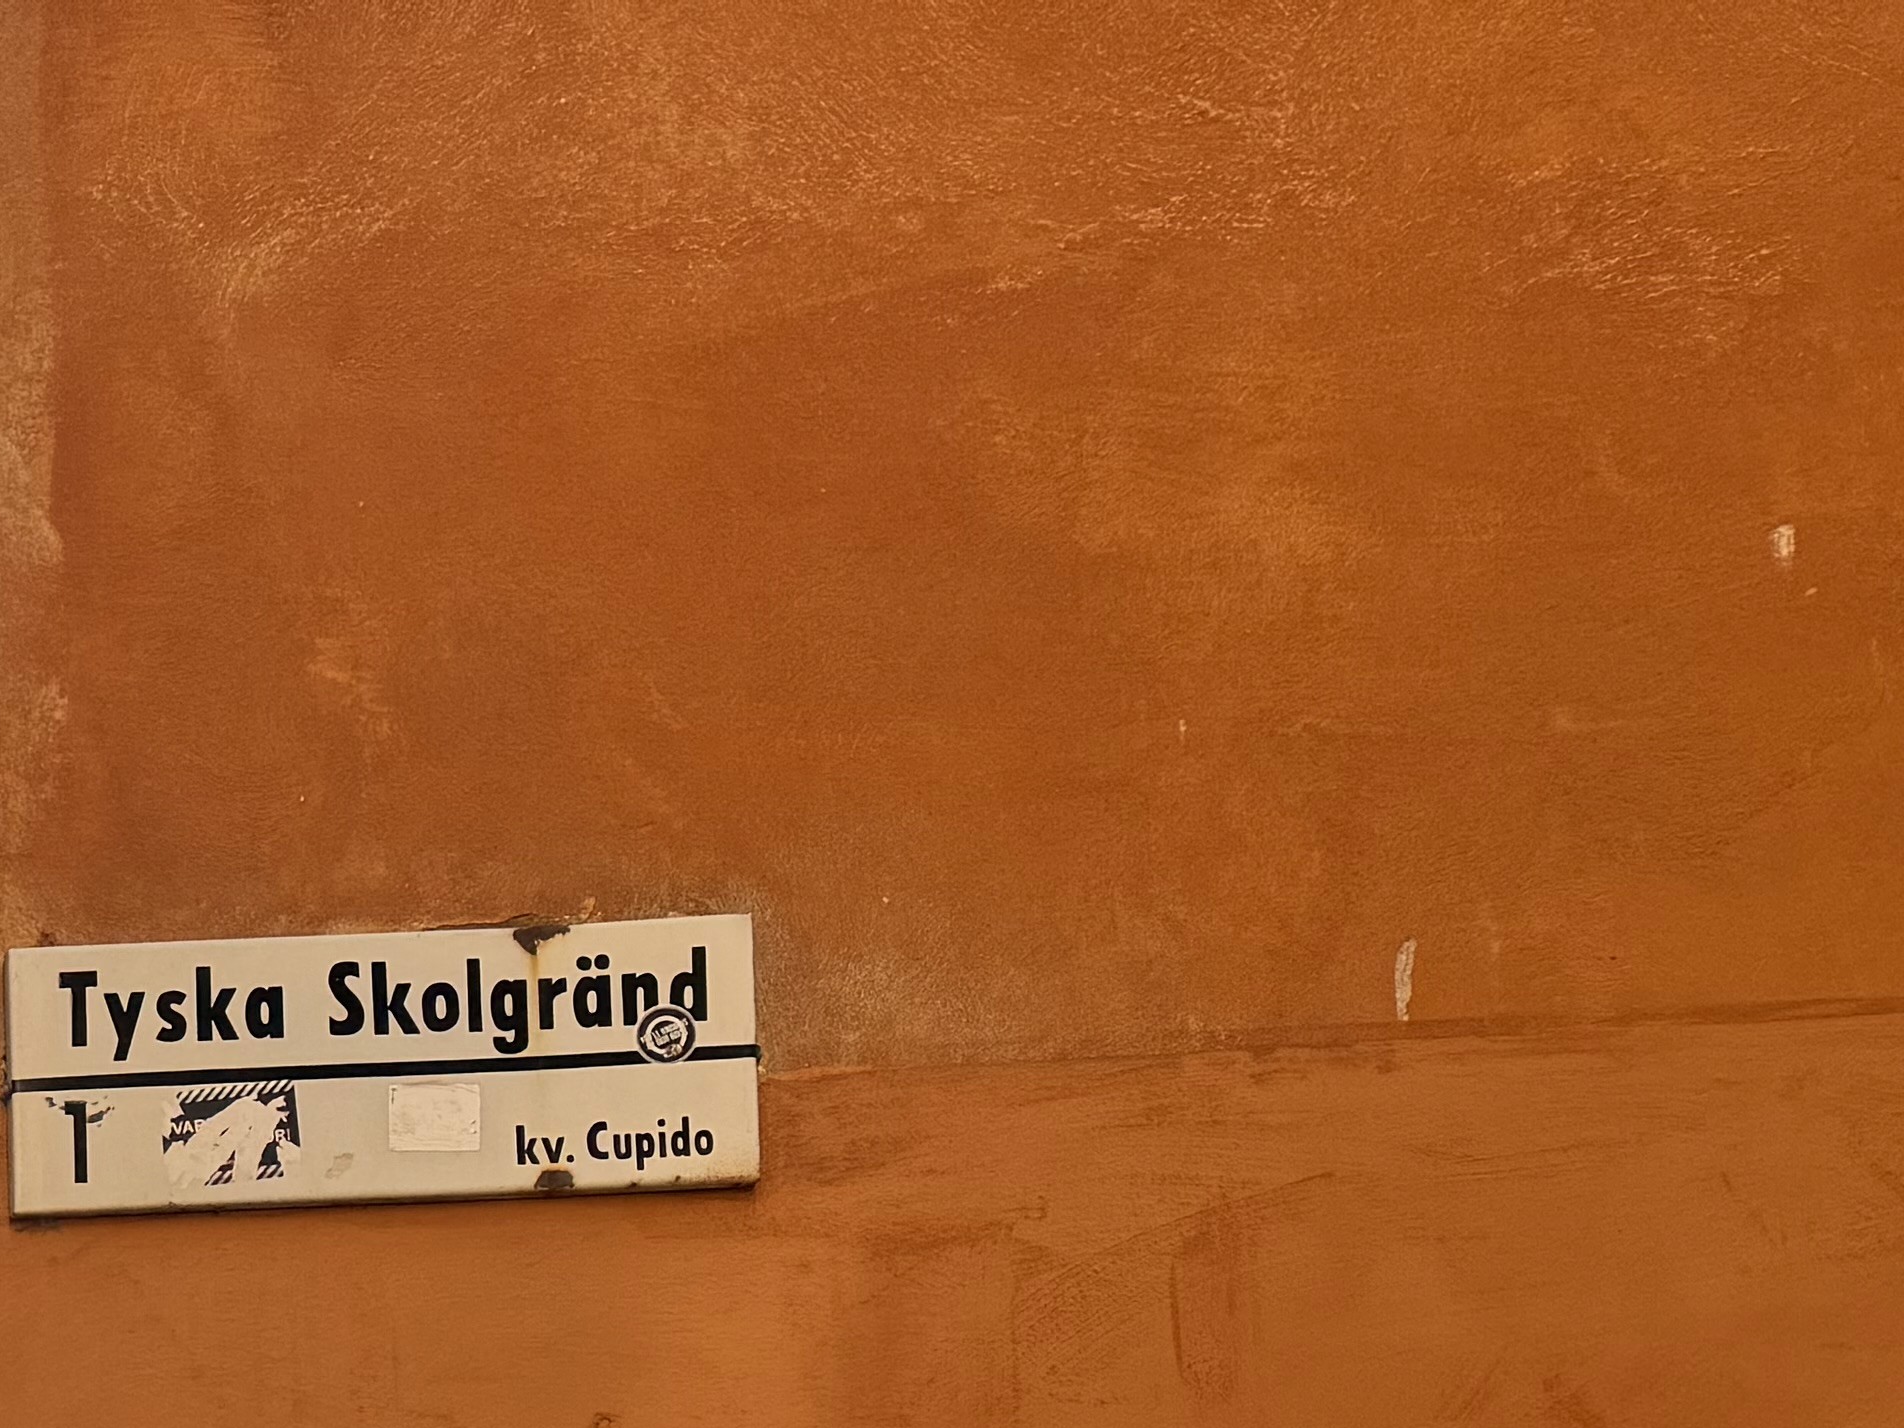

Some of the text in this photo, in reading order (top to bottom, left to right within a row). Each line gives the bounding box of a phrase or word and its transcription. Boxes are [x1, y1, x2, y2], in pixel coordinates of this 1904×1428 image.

[59, 946, 708, 1062] Tyska Skolgränd
[515, 1116, 714, 1171] kv. Cupido
